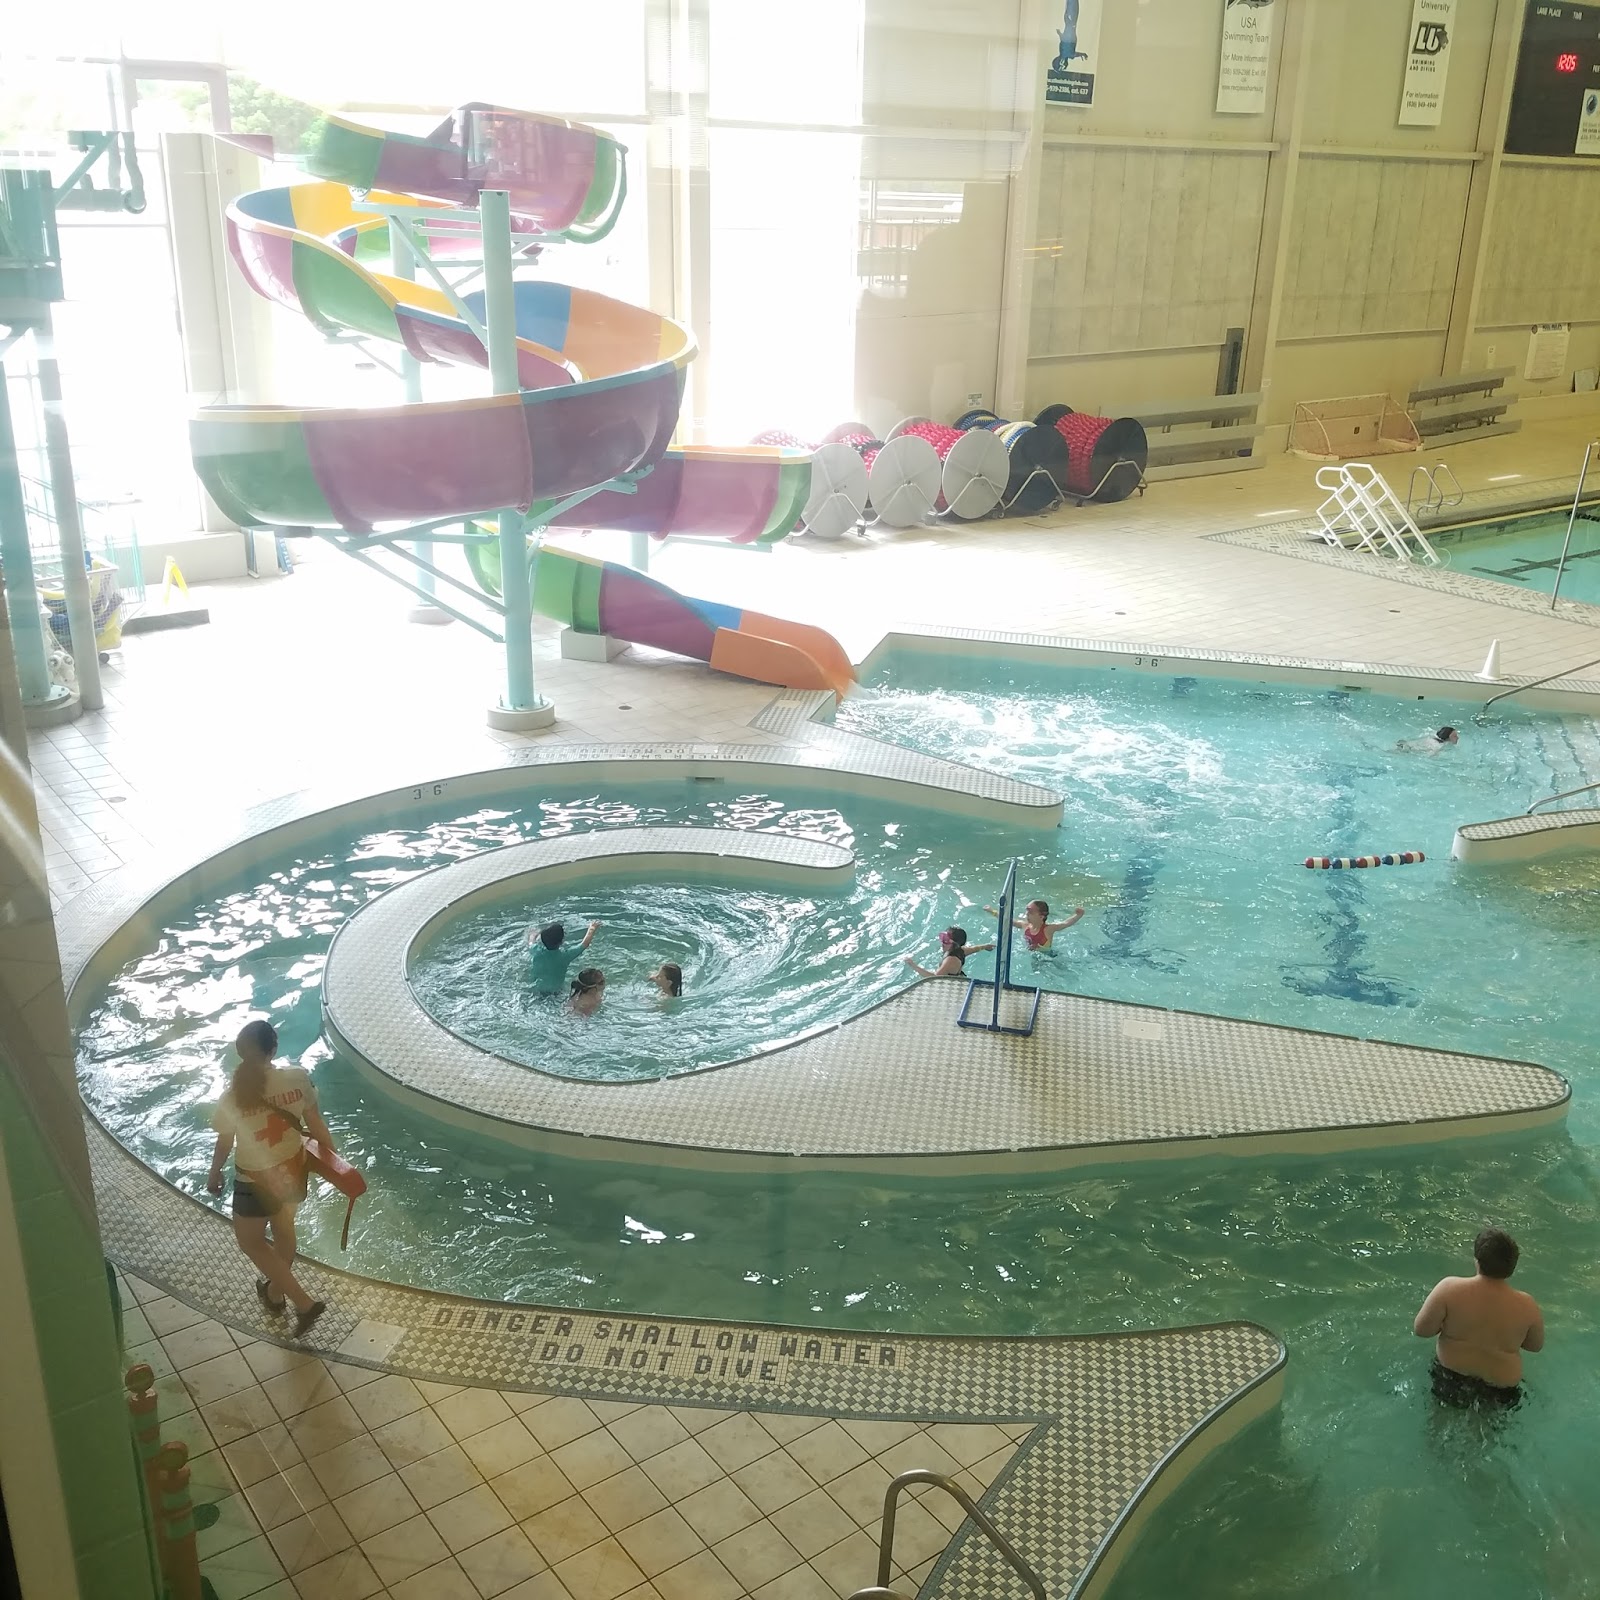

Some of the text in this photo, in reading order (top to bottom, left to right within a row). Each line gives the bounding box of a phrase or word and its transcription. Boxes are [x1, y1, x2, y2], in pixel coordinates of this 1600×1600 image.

[1421, 0, 1450, 13] University
[1241, 16, 1257, 29] USA
[1224, 31, 1269, 44] Swimming Team
[1414, 24, 1445, 53] LU
[262, 1088, 303, 1106] UARD
[432, 1307, 896, 1366] DANGER SHALLOW WATER
[539, 1341, 778, 1381] DO NOT DIVE
